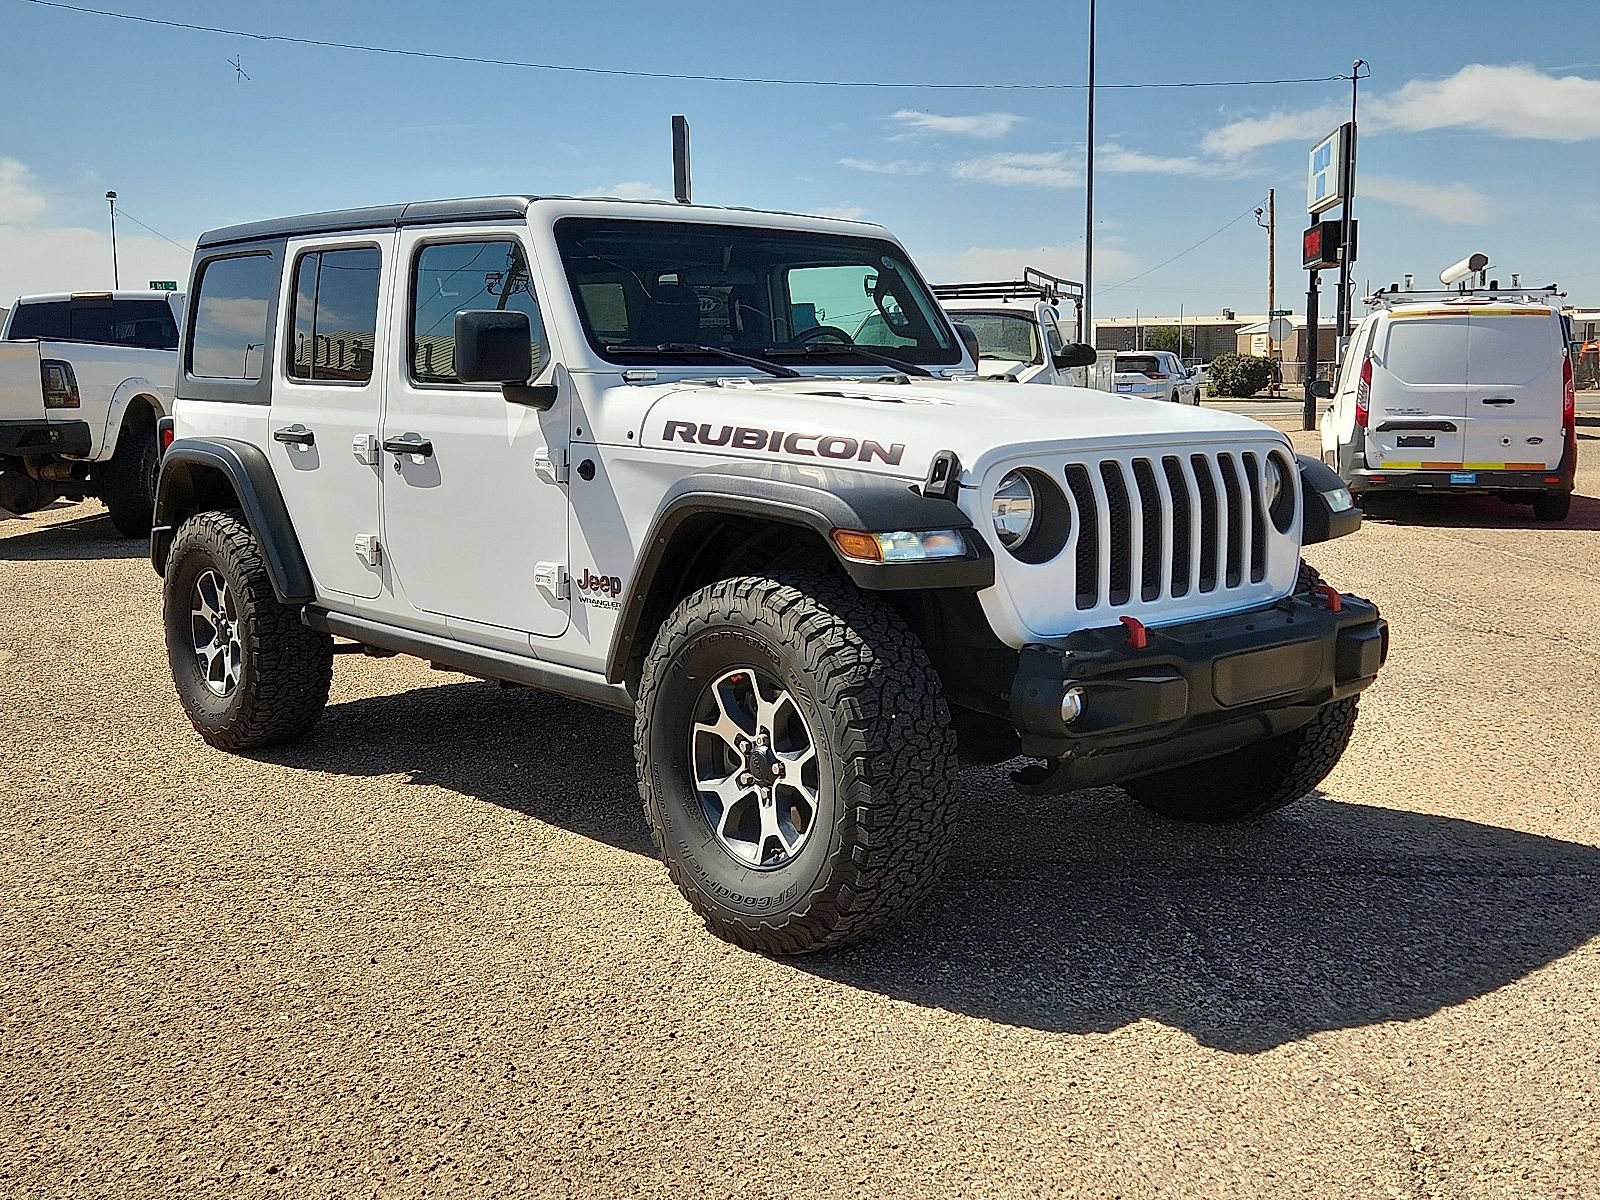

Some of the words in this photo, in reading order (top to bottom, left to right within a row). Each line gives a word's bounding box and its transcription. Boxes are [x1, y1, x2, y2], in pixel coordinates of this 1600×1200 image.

[662, 420, 905, 466] RUBICON
[577, 568, 622, 598] Jeep
[578, 596, 622, 607] WRANGLER
[678, 839, 798, 910] BFGoodrich
